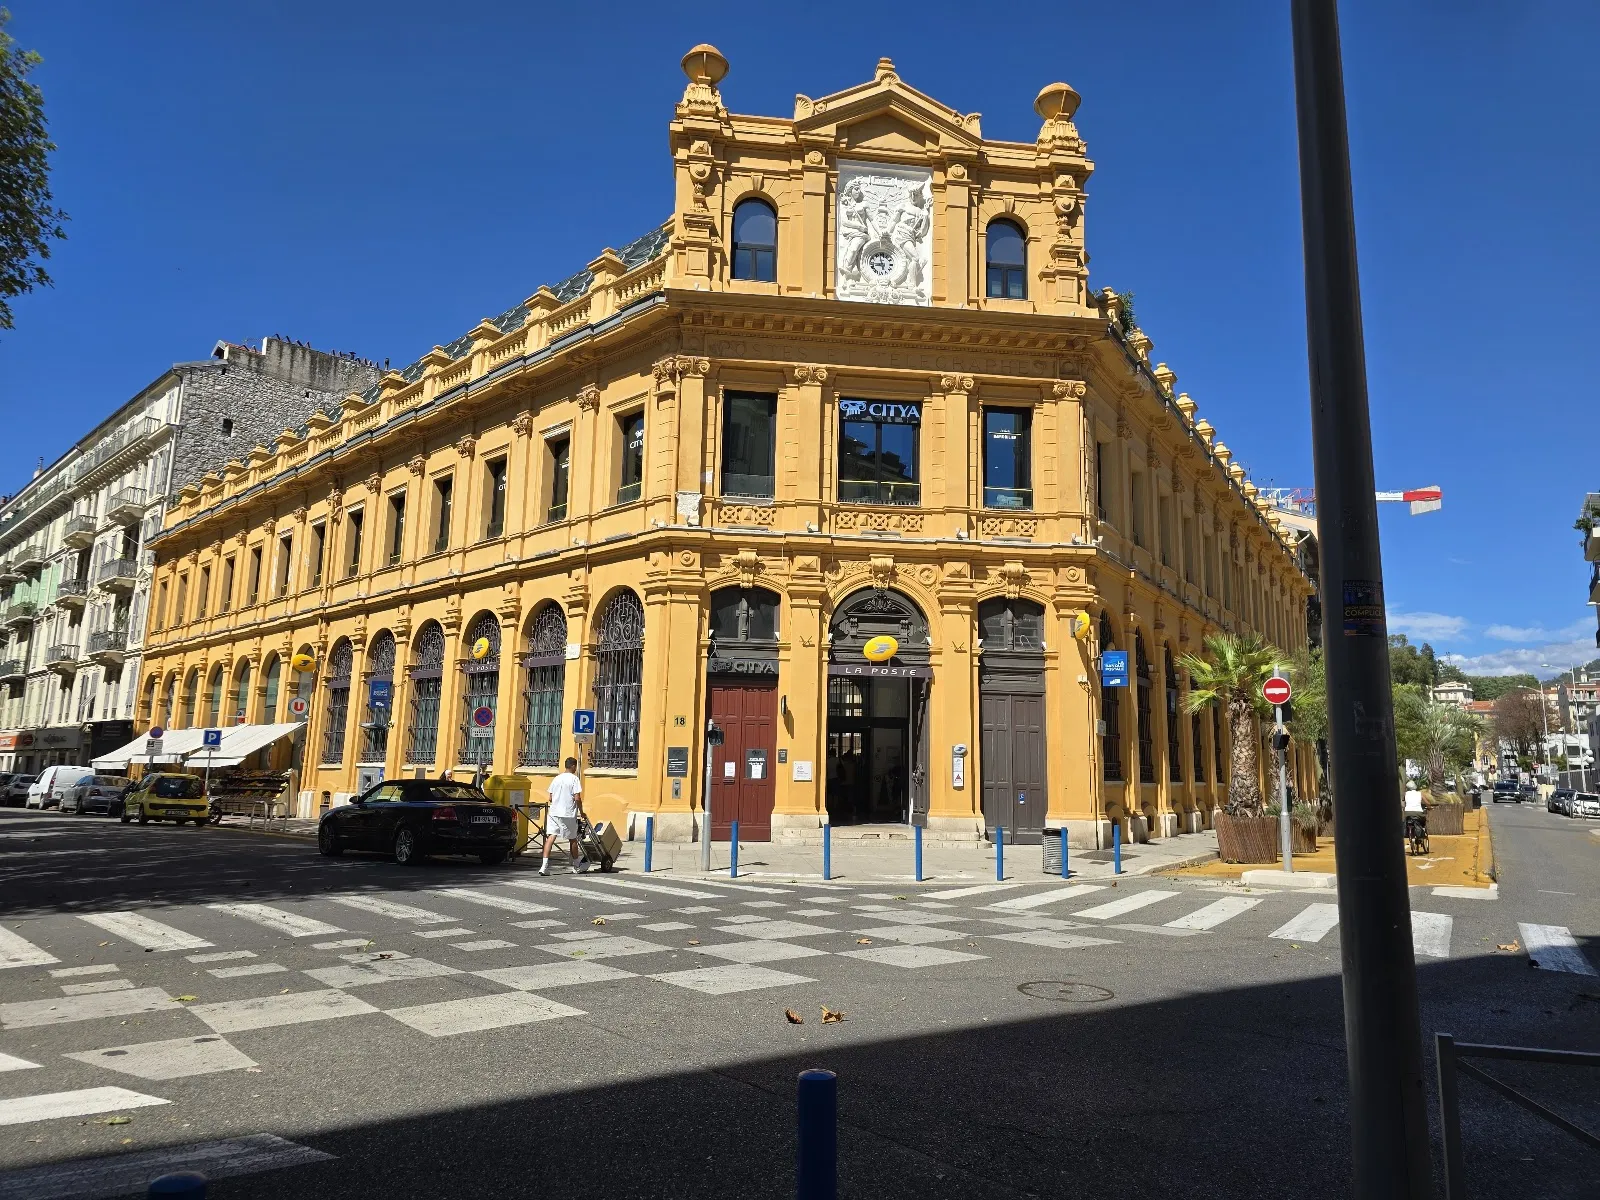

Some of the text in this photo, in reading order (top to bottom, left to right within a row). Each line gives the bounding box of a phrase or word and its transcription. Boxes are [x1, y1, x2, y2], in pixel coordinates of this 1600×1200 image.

[827, 348, 857, 365] ET
[868, 403, 921, 418] CITYA
[1344, 609, 1383, 617] COMPLICE
[733, 660, 776, 672] CITYA
[871, 667, 917, 676] POSTE
[293, 701, 304, 712] U
[579, 714, 590, 730] P
[674, 717, 686, 726] 18
[207, 732, 217, 743] P
